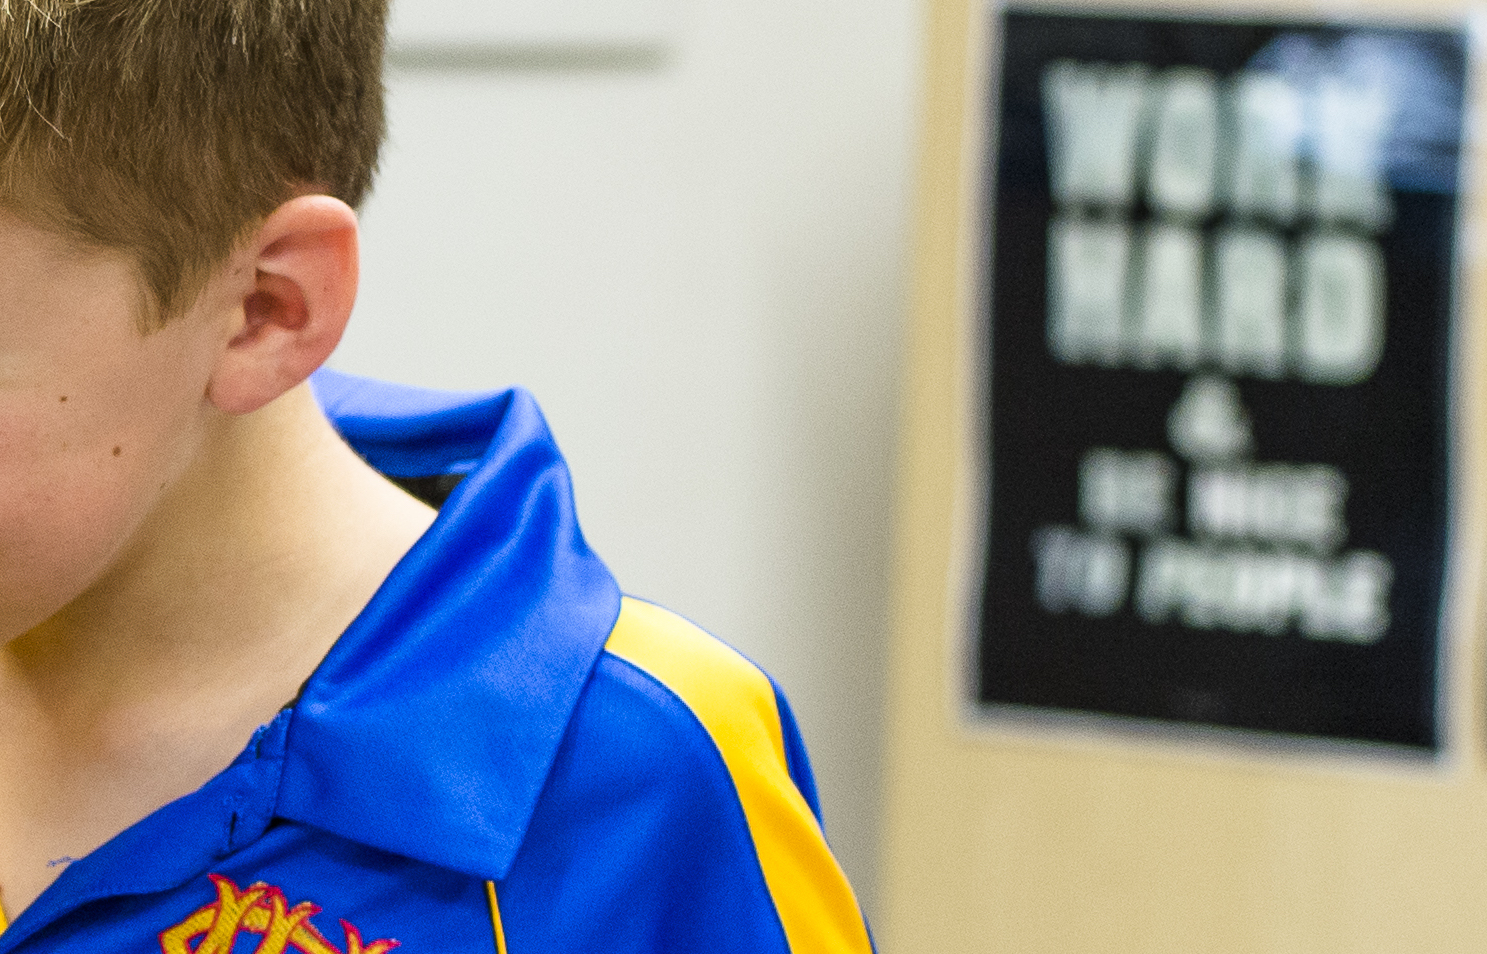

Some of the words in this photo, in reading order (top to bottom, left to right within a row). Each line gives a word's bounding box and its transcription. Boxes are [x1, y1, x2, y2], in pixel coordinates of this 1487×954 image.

[1042, 60, 1394, 235] WORK
[1047, 218, 1387, 384] HARD
[1133, 540, 1393, 645] PEOPLE
